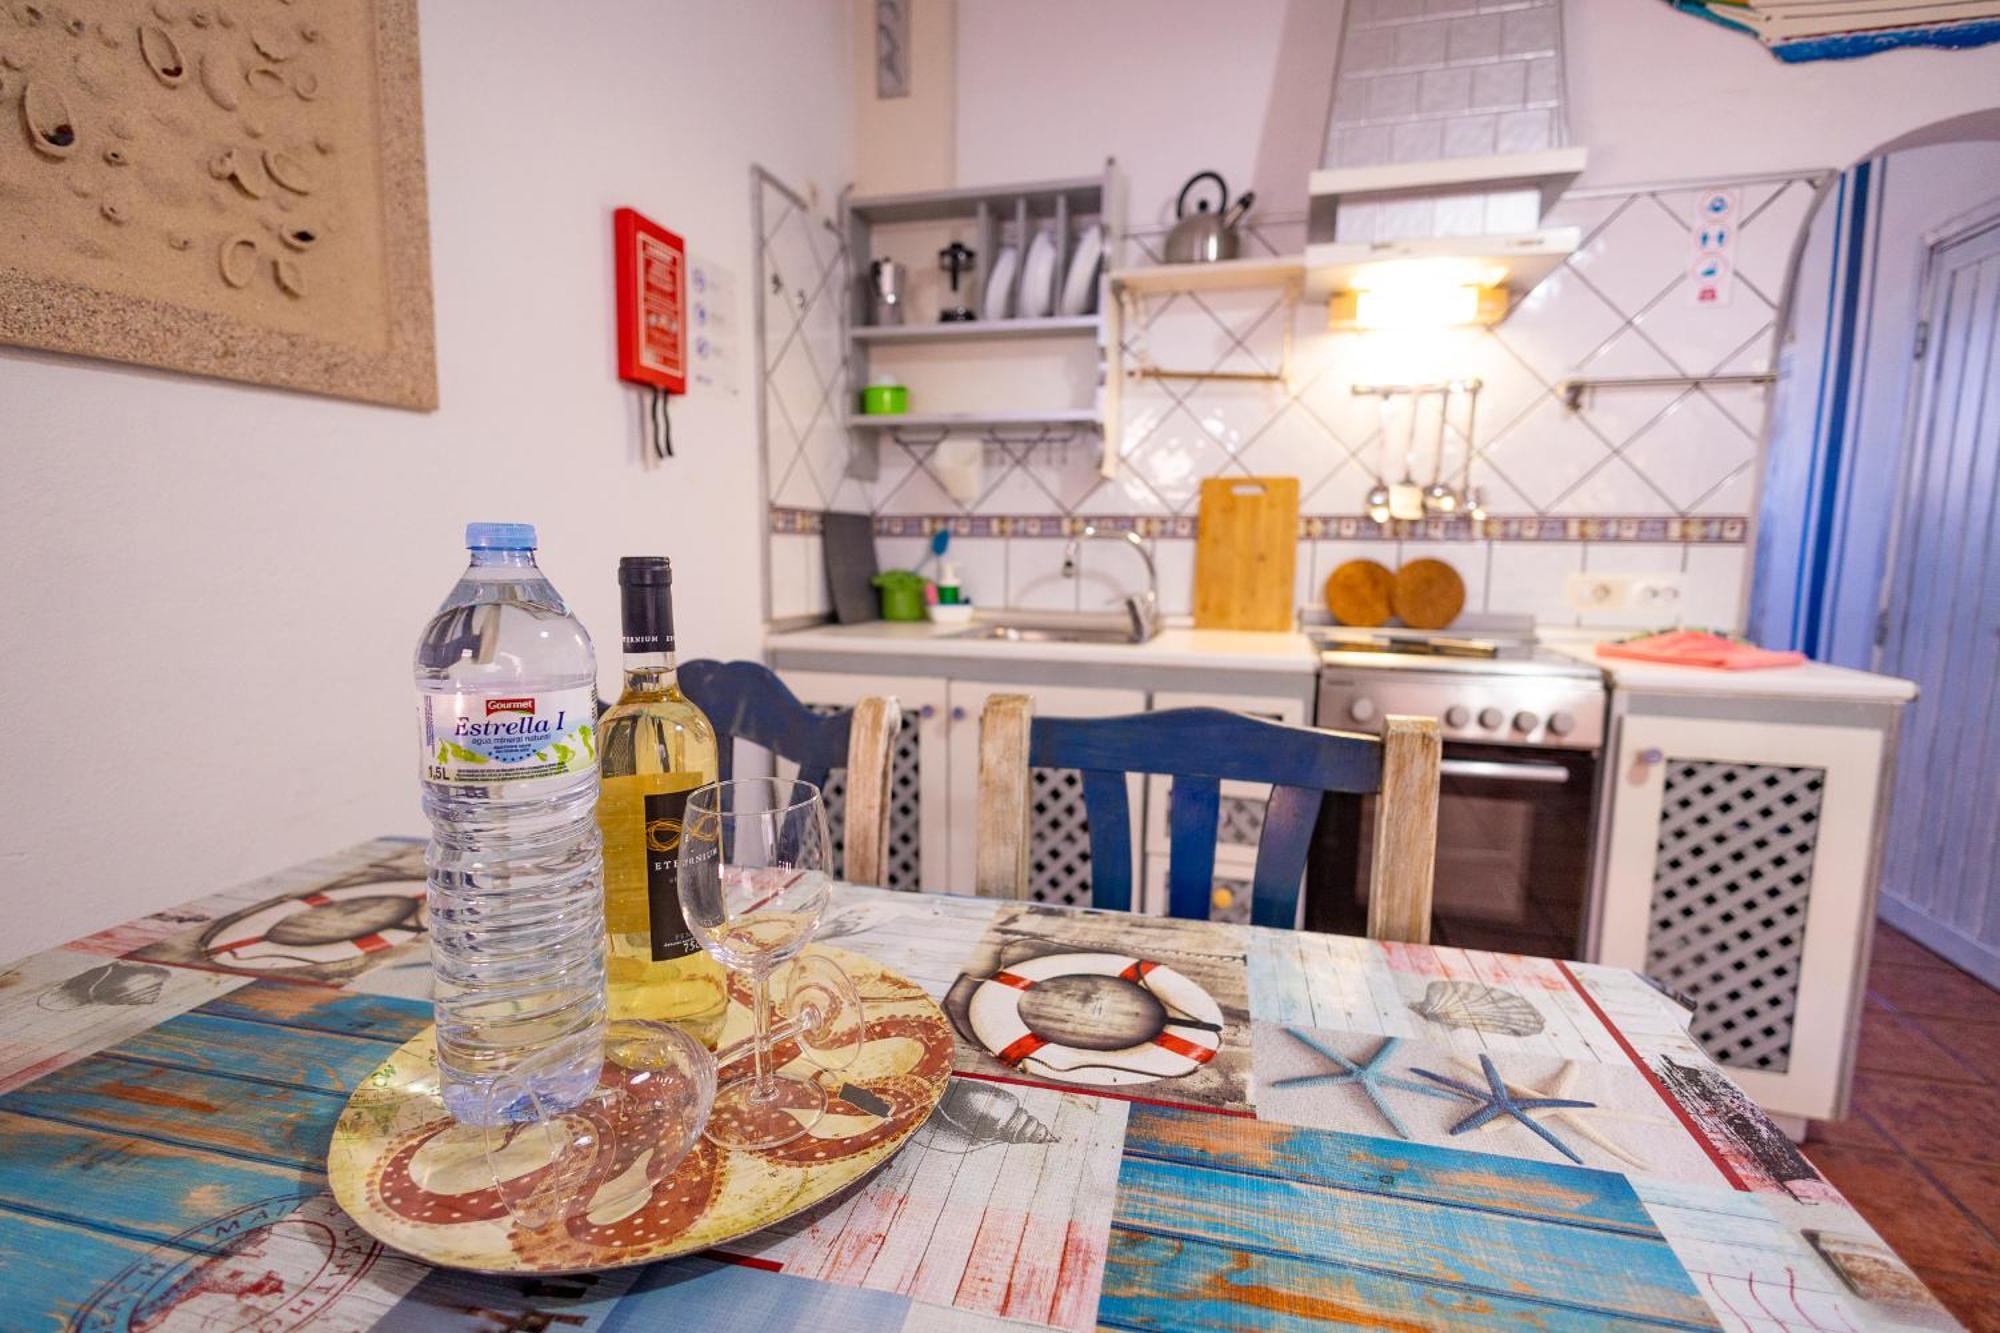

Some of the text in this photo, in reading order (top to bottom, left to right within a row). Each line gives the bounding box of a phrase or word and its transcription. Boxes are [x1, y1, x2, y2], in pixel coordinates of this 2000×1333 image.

[488, 700, 533, 710] Gourmet
[455, 716, 550, 736] Estrella
[472, 737, 492, 746] agua
[493, 735, 524, 744] mineral
[525, 733, 552, 742] natural
[214, 1200, 304, 1238] MAIL
